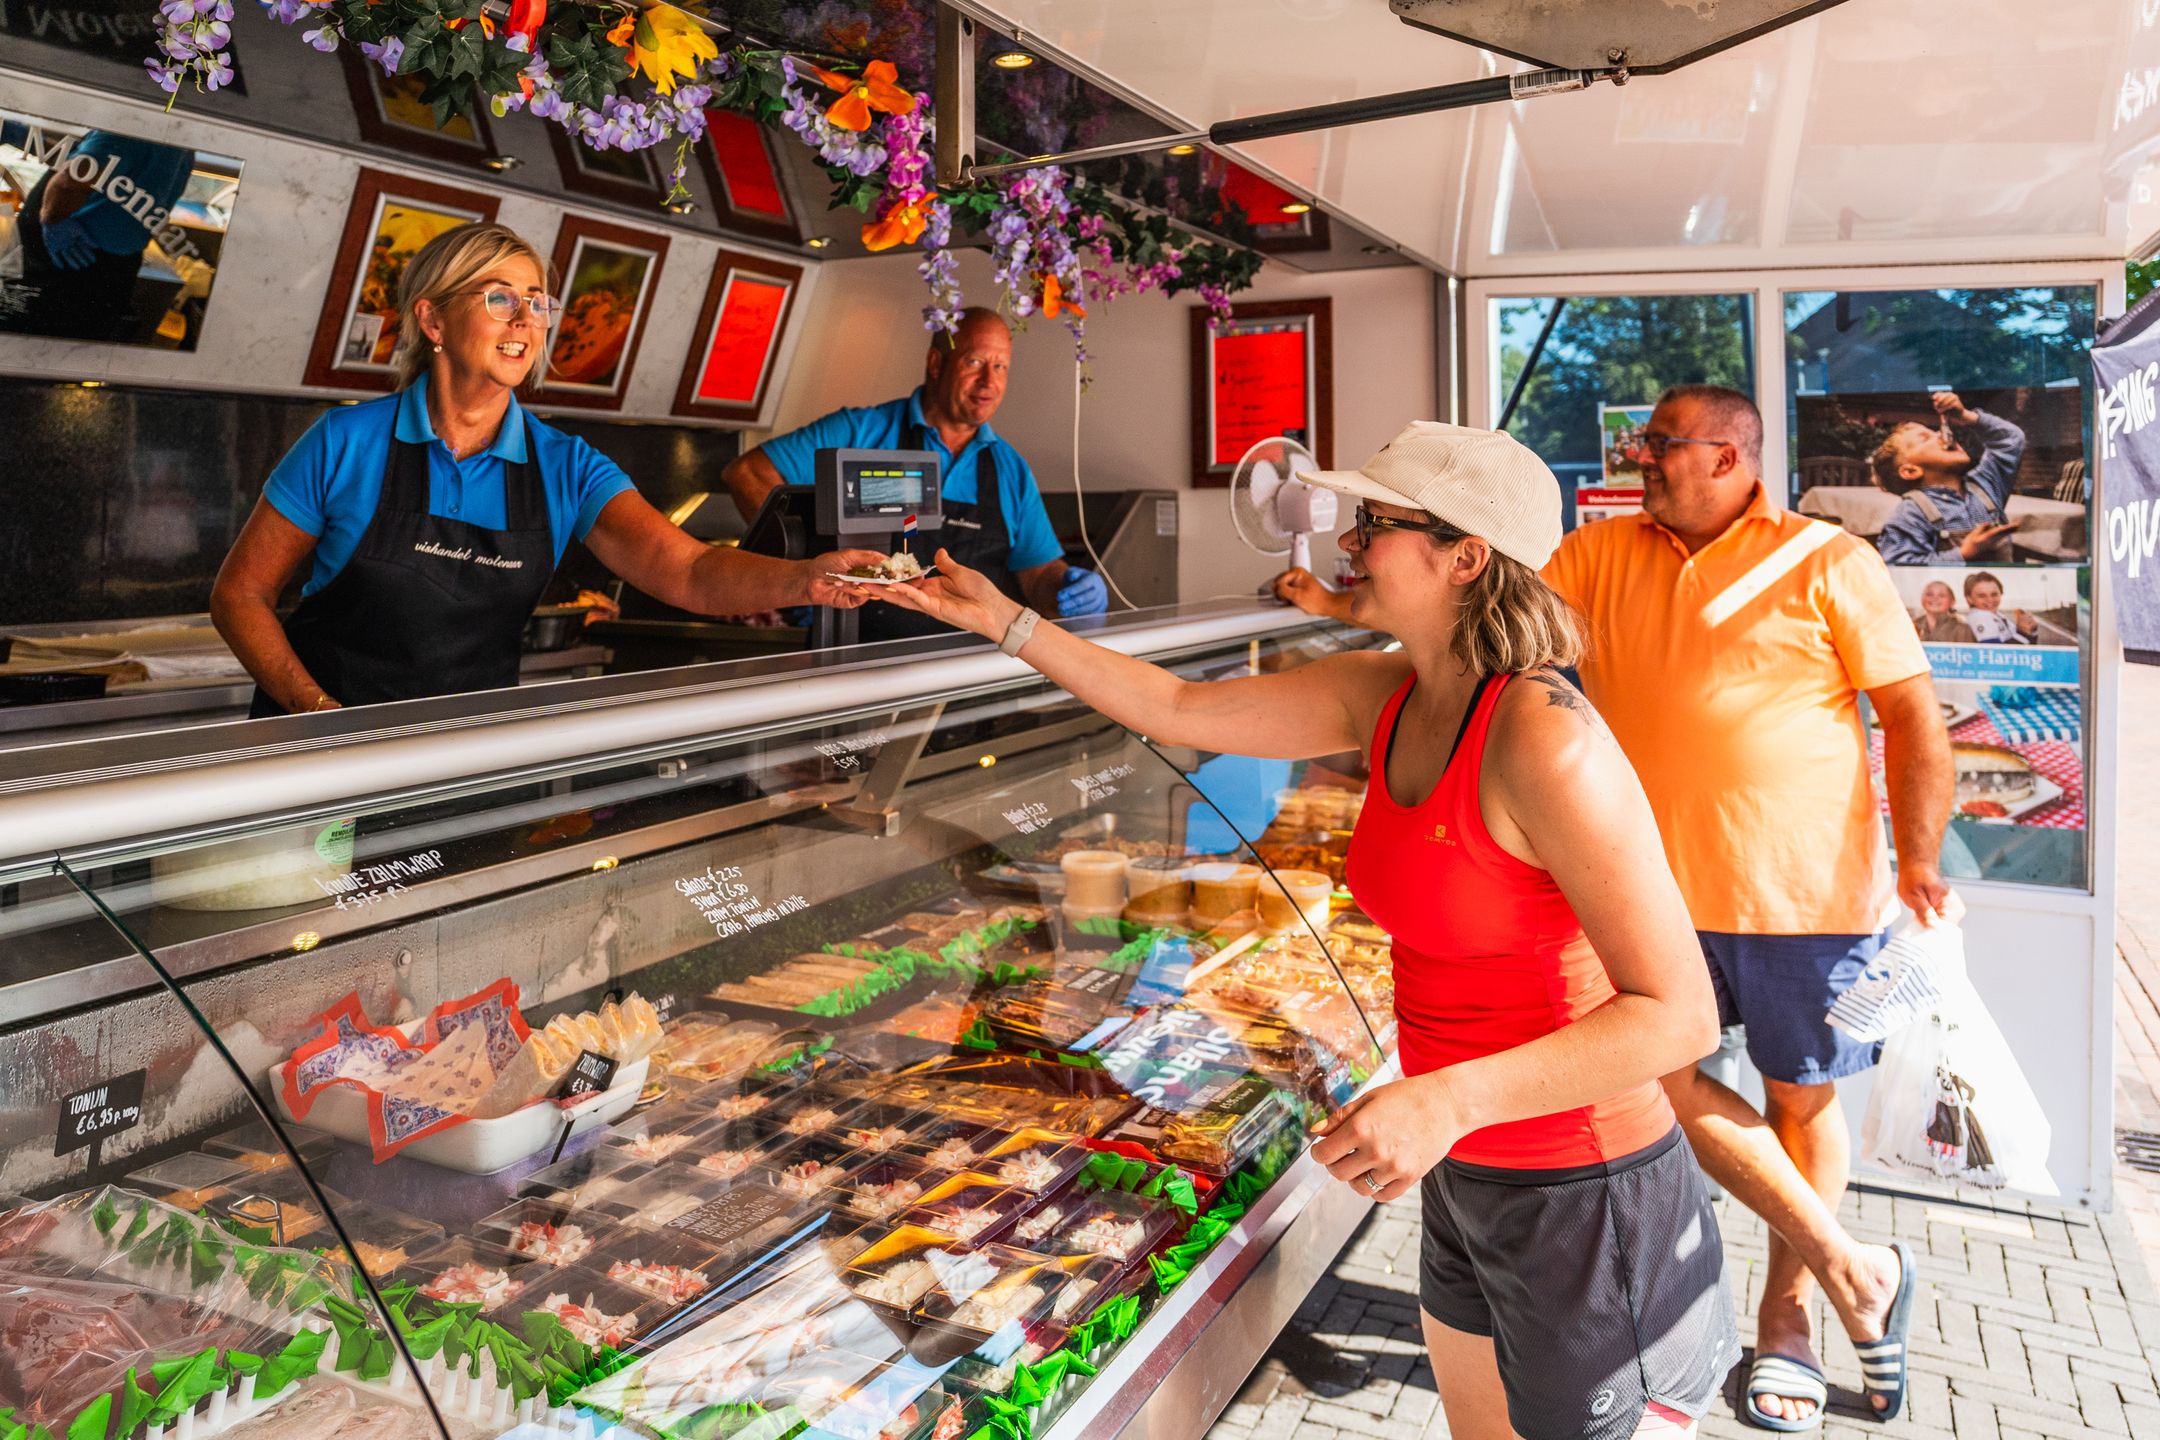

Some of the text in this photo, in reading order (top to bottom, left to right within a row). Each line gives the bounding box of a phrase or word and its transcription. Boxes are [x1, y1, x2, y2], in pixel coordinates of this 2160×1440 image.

[22, 126, 199, 259] Molenaar
[414, 541, 472, 561] vishandel
[1926, 647, 2043, 671] oodje Haring
[360, 849, 445, 885] ZALMWRAP
[68, 1086, 109, 1115] TONIJN
